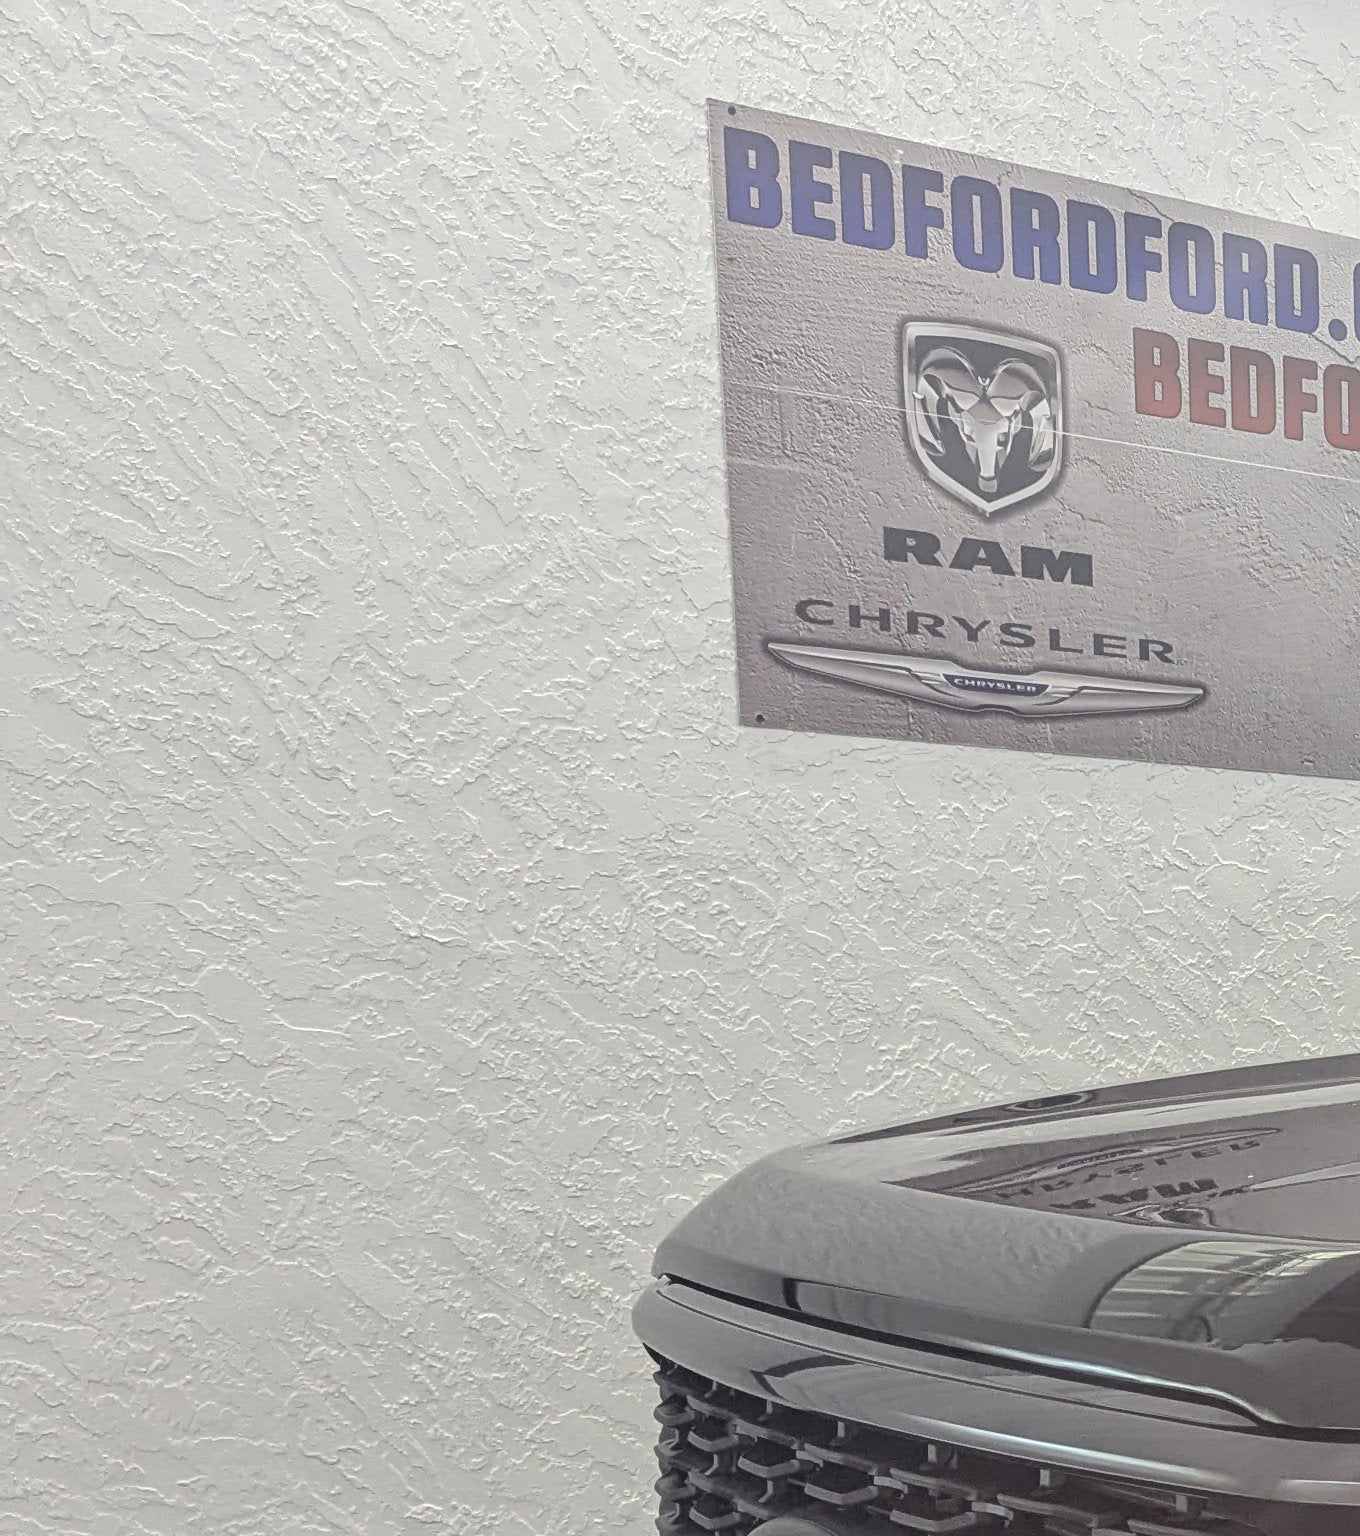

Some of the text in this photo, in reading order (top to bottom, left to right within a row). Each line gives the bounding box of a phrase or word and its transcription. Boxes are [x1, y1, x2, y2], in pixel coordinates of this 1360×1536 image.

[883, 526, 1094, 587] RAM
[795, 599, 1173, 663] CHRYSLER
[953, 678, 1037, 693] CHRYSLER
